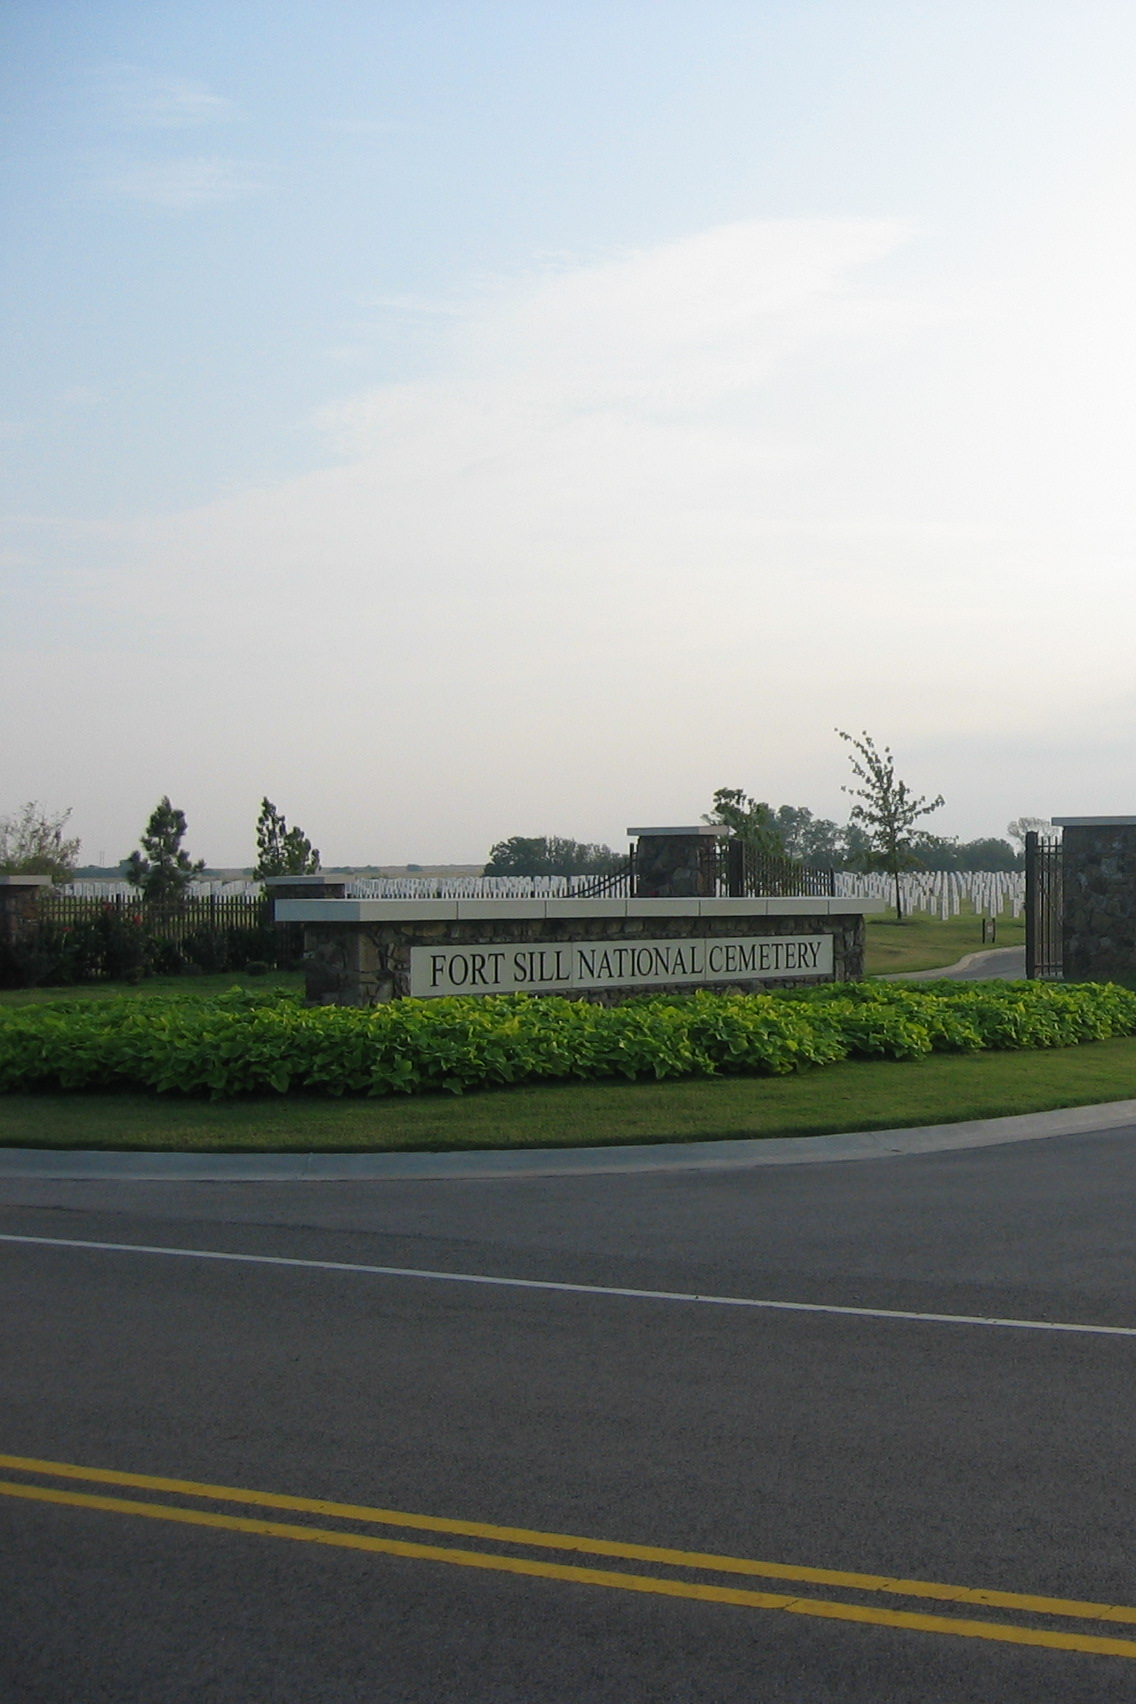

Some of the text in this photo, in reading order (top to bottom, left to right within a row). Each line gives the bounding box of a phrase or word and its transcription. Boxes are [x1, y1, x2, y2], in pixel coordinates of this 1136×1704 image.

[430, 942, 822, 987] FORT SILL NATIONAL CEMETERY
